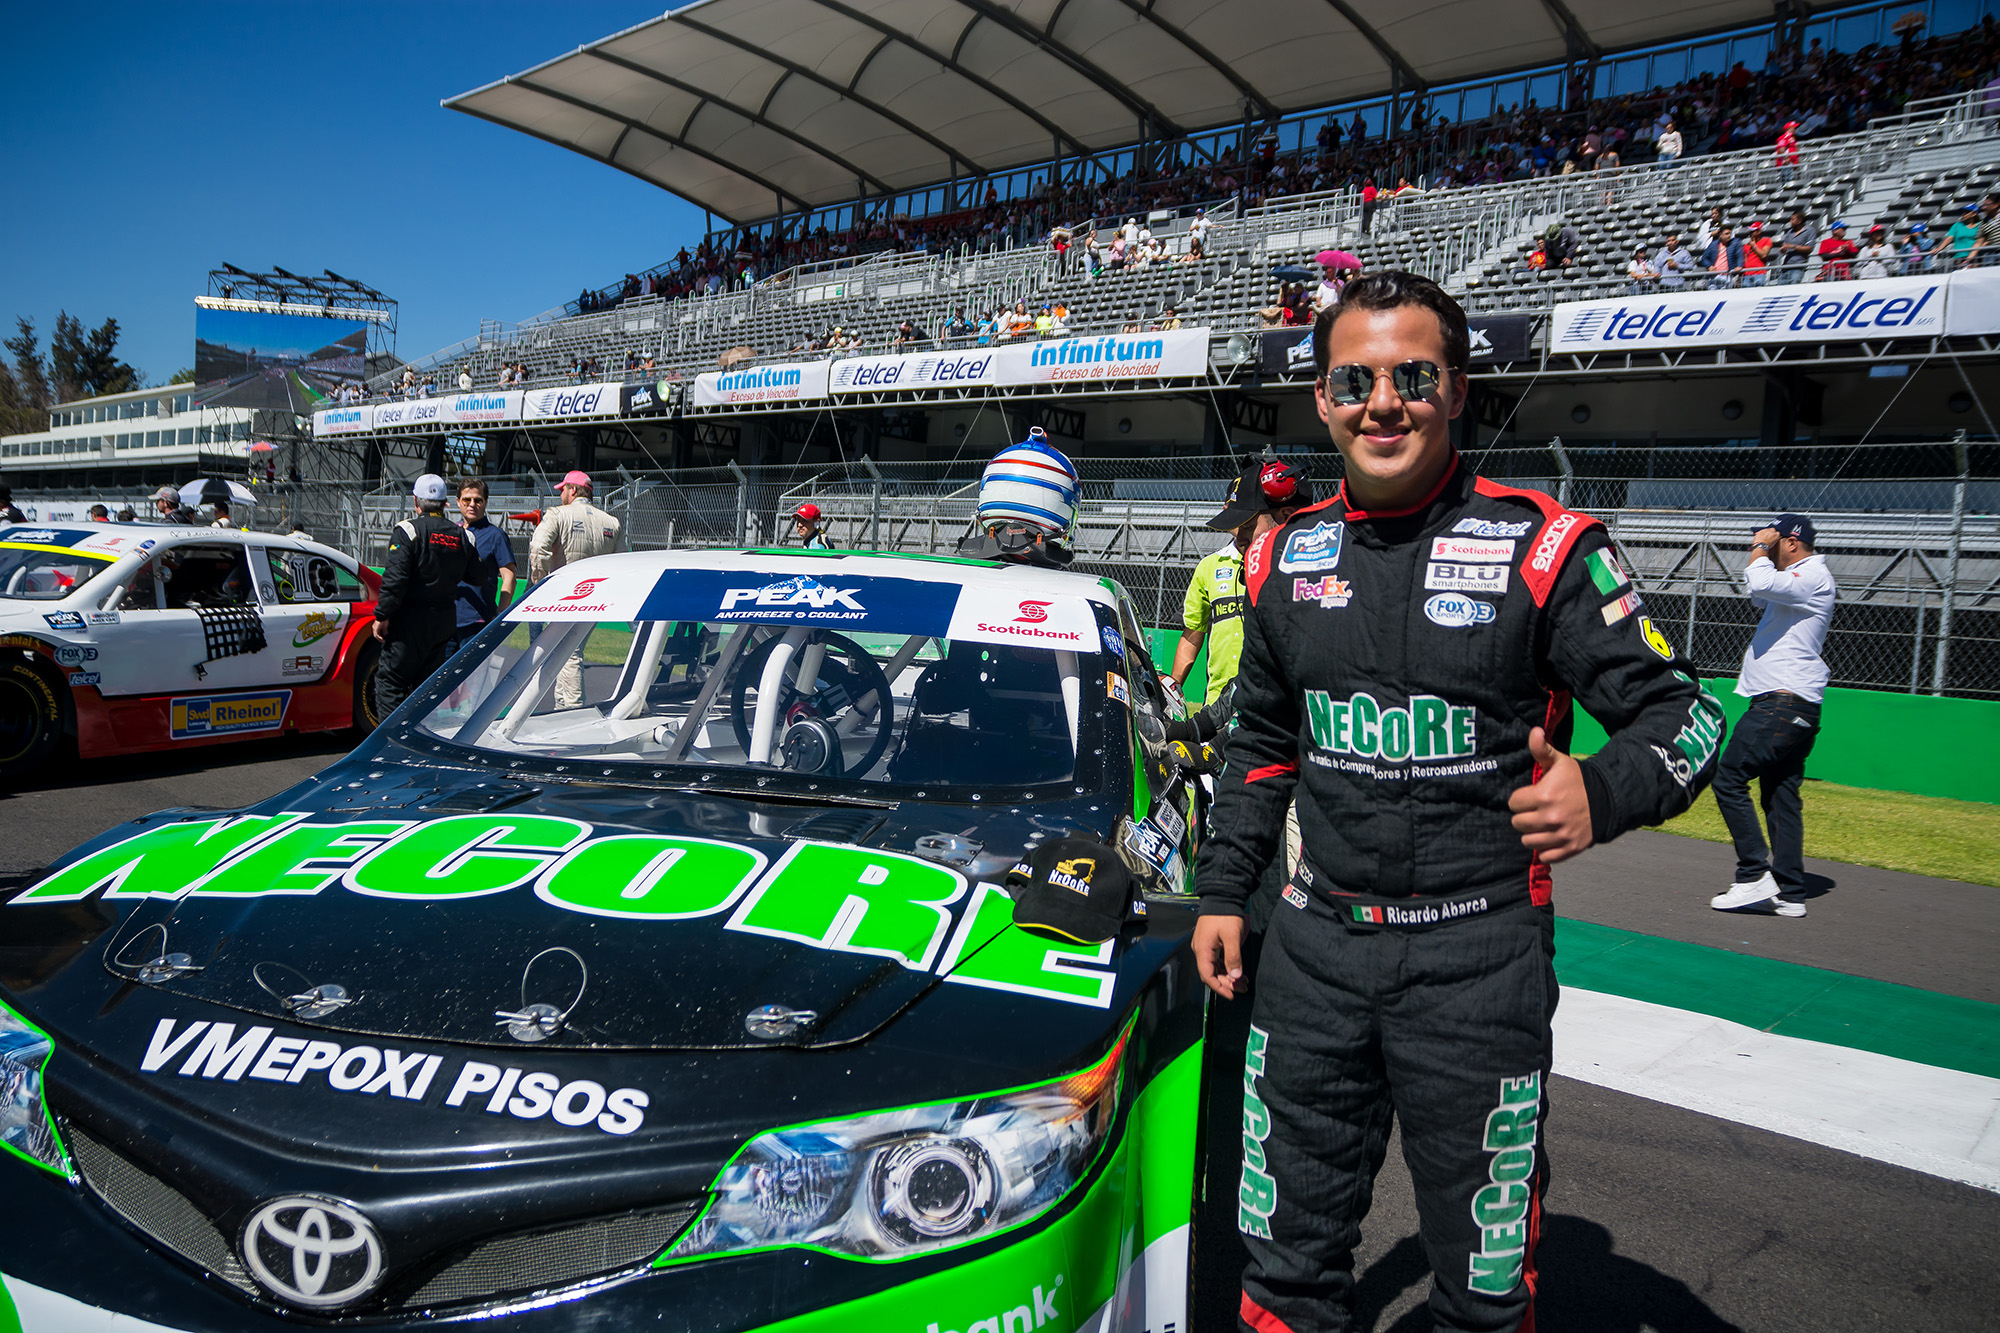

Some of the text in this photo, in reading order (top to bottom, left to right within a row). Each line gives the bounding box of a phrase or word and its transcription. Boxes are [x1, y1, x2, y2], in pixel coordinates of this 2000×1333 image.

[1788, 286, 1940, 332] telcel
[1603, 300, 1728, 341] telcel
[1031, 337, 1164, 367] infinitum
[852, 360, 906, 386] telcel
[931, 354, 993, 382] telcel
[1051, 361, 1161, 380] Exceso de Velocidad
[716, 367, 801, 392] infinitum
[455, 393, 506, 412] infinitum
[553, 386, 604, 416] telcel
[631, 390, 653, 407] PEAK
[730, 387, 800, 403] Exceso de Velocidad
[324, 407, 361, 425] infinitum
[382, 408, 404, 423] telcel
[414, 404, 439, 421] telcel
[1474, 521, 1531, 536] telcel
[1294, 527, 1338, 551] PEAK
[1450, 545, 1511, 556] Scotiabank
[1295, 576, 1350, 601] FedEx
[1431, 579, 1499, 592] smartphones
[521, 603, 609, 613] Scotiabank
[719, 587, 867, 611] PEAK
[48, 612, 81, 624] PEAK
[714, 610, 869, 621] ANTIFREEZE COOLANT
[1435, 612, 1466, 620] SPORTS
[1437, 600, 1492, 620] FOX 3
[977, 622, 1081, 641] Scotiabank
[61, 648, 81, 658] FOX
[87, 648, 96, 660] 3
[70, 673, 100, 686] telcel
[13, 665, 59, 721] CONTINENTAL
[188, 707, 210, 721] Swd
[215, 702, 277, 722] Rheinol
[1403, 768, 1410, 781] y
[1138, 824, 1163, 862] PEAK
[10, 812, 1117, 1010] NECORE
[1386, 896, 1488, 924] Ricardo Abarca
[445, 1060, 650, 1137] PISOS
